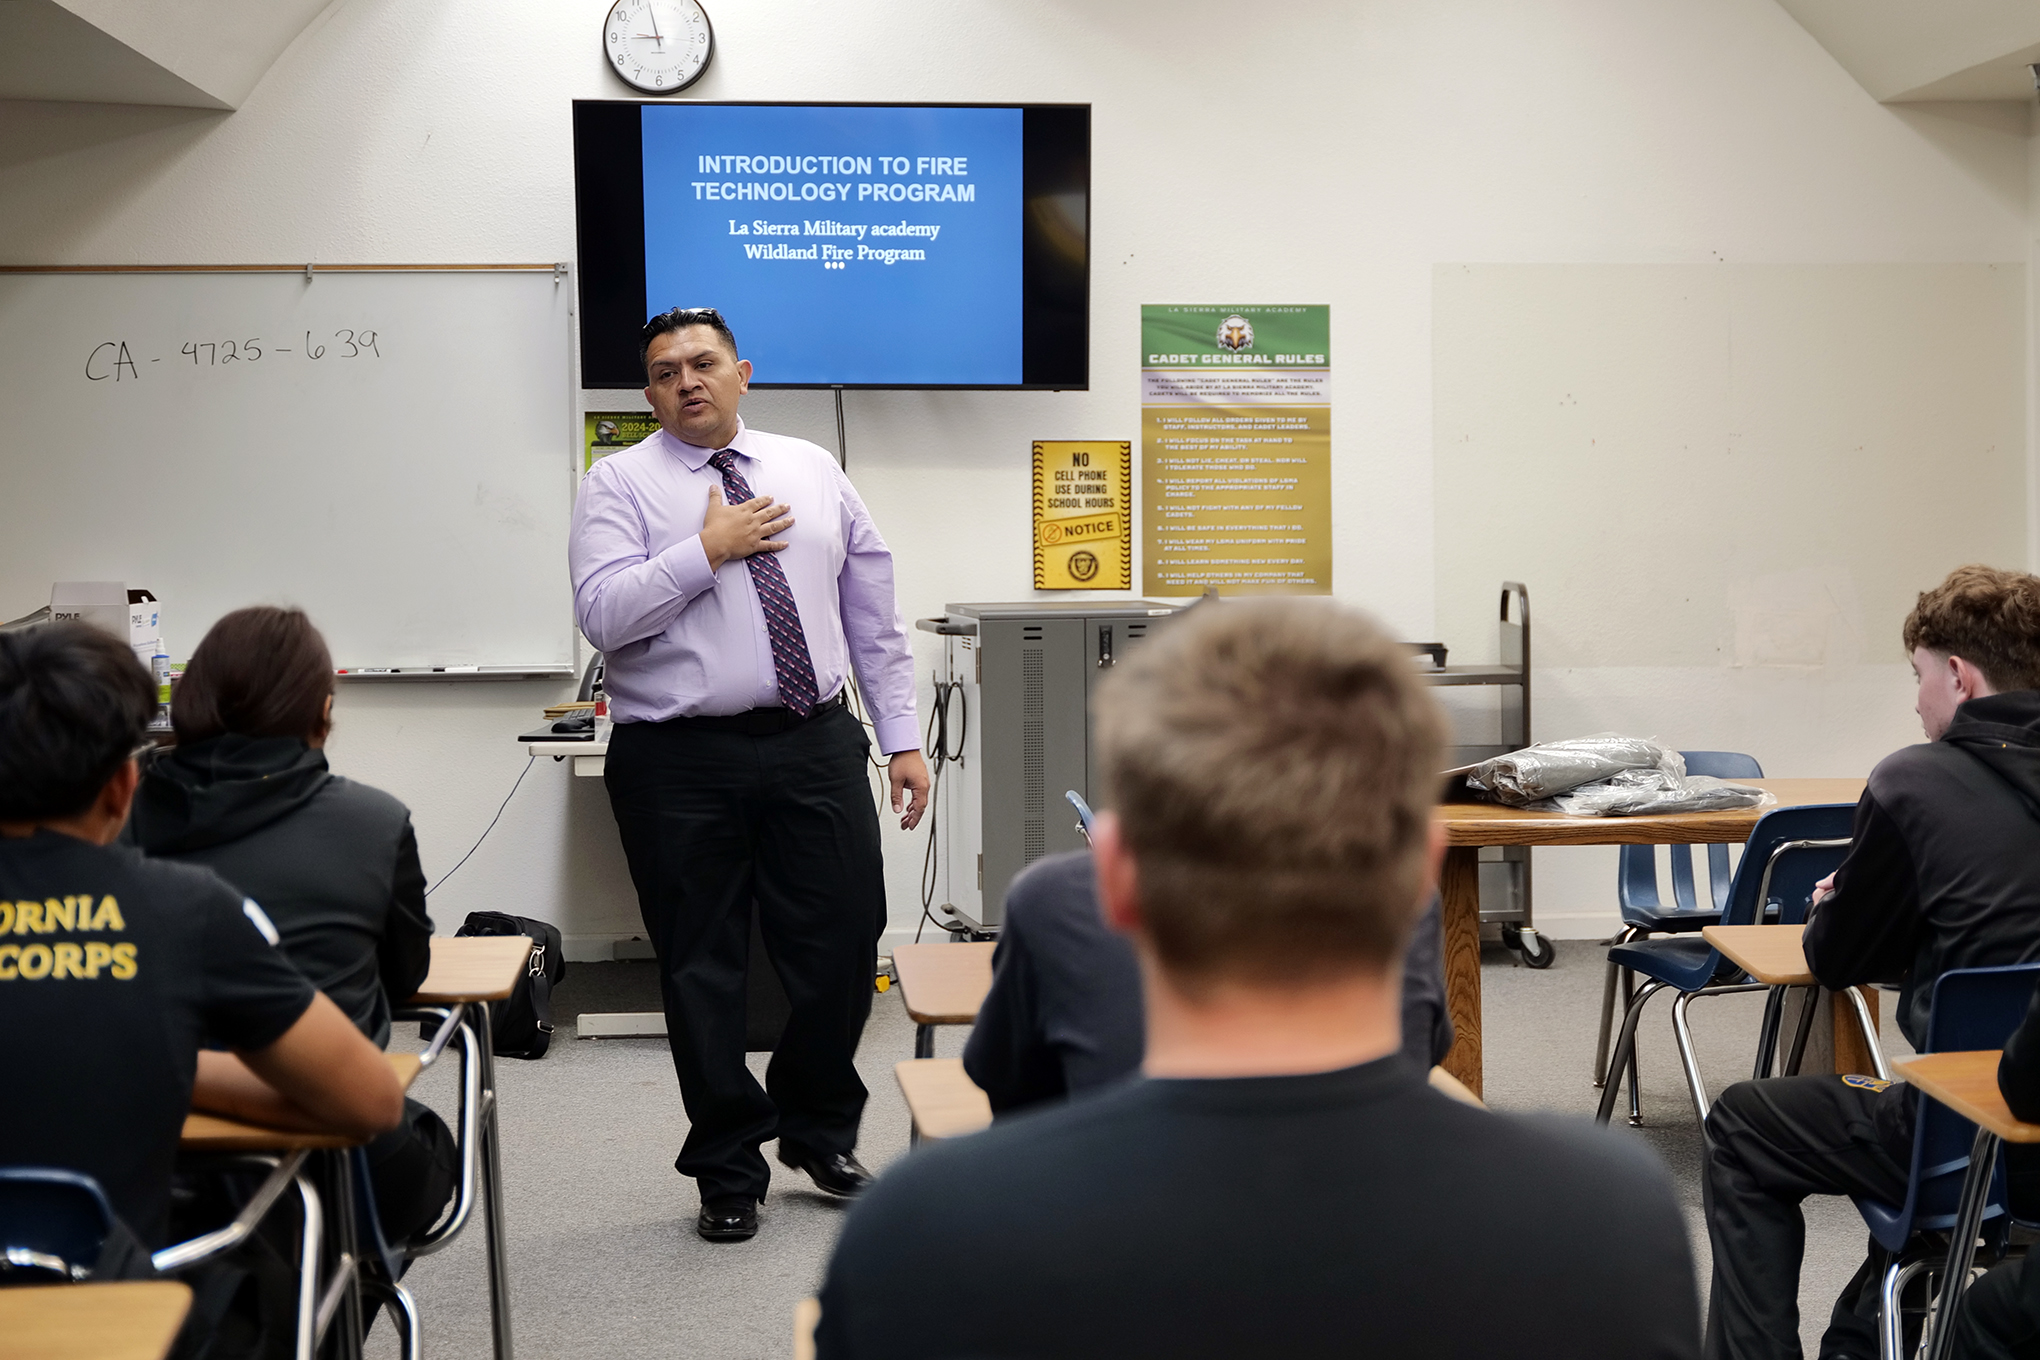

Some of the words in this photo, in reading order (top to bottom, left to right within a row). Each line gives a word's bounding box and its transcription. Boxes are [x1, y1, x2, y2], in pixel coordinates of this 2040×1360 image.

[615, 10, 627, 22] 10
[692, 11, 700, 23] 2
[610, 32, 618, 43] 9
[698, 32, 706, 44] 3
[617, 54, 625, 66] 8
[692, 54, 700, 65] 4
[633, 69, 641, 80] 7
[677, 69, 685, 81] 5
[655, 75, 663, 87] 6
[698, 155, 872, 175] INTRODUCTION
[878, 156, 911, 175] TO
[916, 156, 968, 176] FIRE
[691, 182, 852, 201] TECHNOLOGY
[858, 183, 976, 202] PROGRAM
[729, 219, 749, 235] La
[752, 219, 800, 236] Sierra
[803, 220, 868, 240] Military
[871, 221, 941, 241] academy
[744, 243, 818, 260] Wildland
[821, 244, 854, 261] Fire
[856, 245, 926, 265] Program
[85, 340, 138, 382] CA
[181, 337, 262, 366] 4725
[306, 329, 380, 360] 639
[1149, 354, 1198, 364] CADET
[1202, 354, 1273, 364] GENERAL
[1275, 354, 1325, 364] RULES
[621, 422, 661, 432] 2024-20
[1072, 452, 1090, 467] NO
[1054, 470, 1075, 481] CELL
[1078, 470, 1108, 481] PHONE
[1055, 484, 1071, 494] USE
[1074, 484, 1107, 494] DURING
[1047, 498, 1083, 508] SCHOOL
[1085, 498, 1115, 508] HOURS
[1064, 520, 1114, 537] NOTICE
[55, 612, 81, 621] PYLE
[0, 942, 138, 981] CORPS
